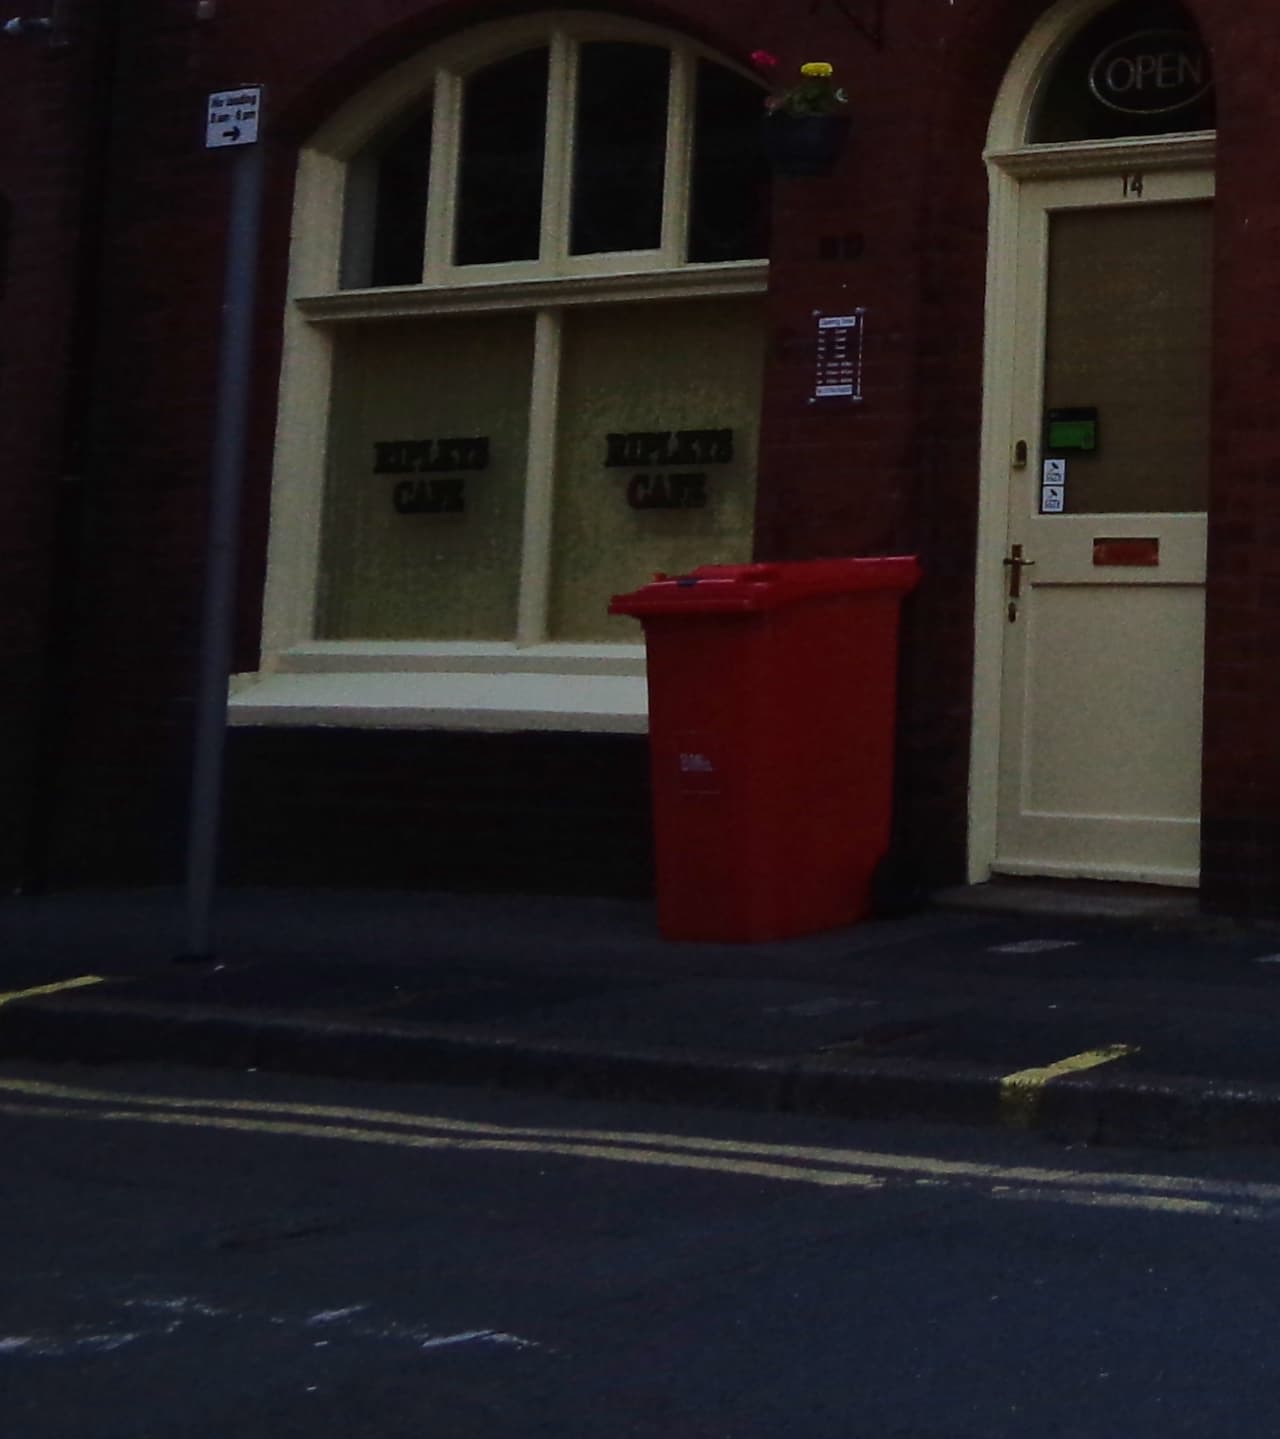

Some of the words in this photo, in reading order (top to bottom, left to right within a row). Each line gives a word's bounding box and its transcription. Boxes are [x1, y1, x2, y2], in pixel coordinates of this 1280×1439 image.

[1106, 52, 1202, 93] OPEN
[1122, 172, 1143, 198] 14
[374, 437, 489, 473] RIPLEYS
[606, 429, 733, 467] RIPLEYS
[394, 479, 464, 513] CAFE
[628, 473, 706, 509] CAFE
